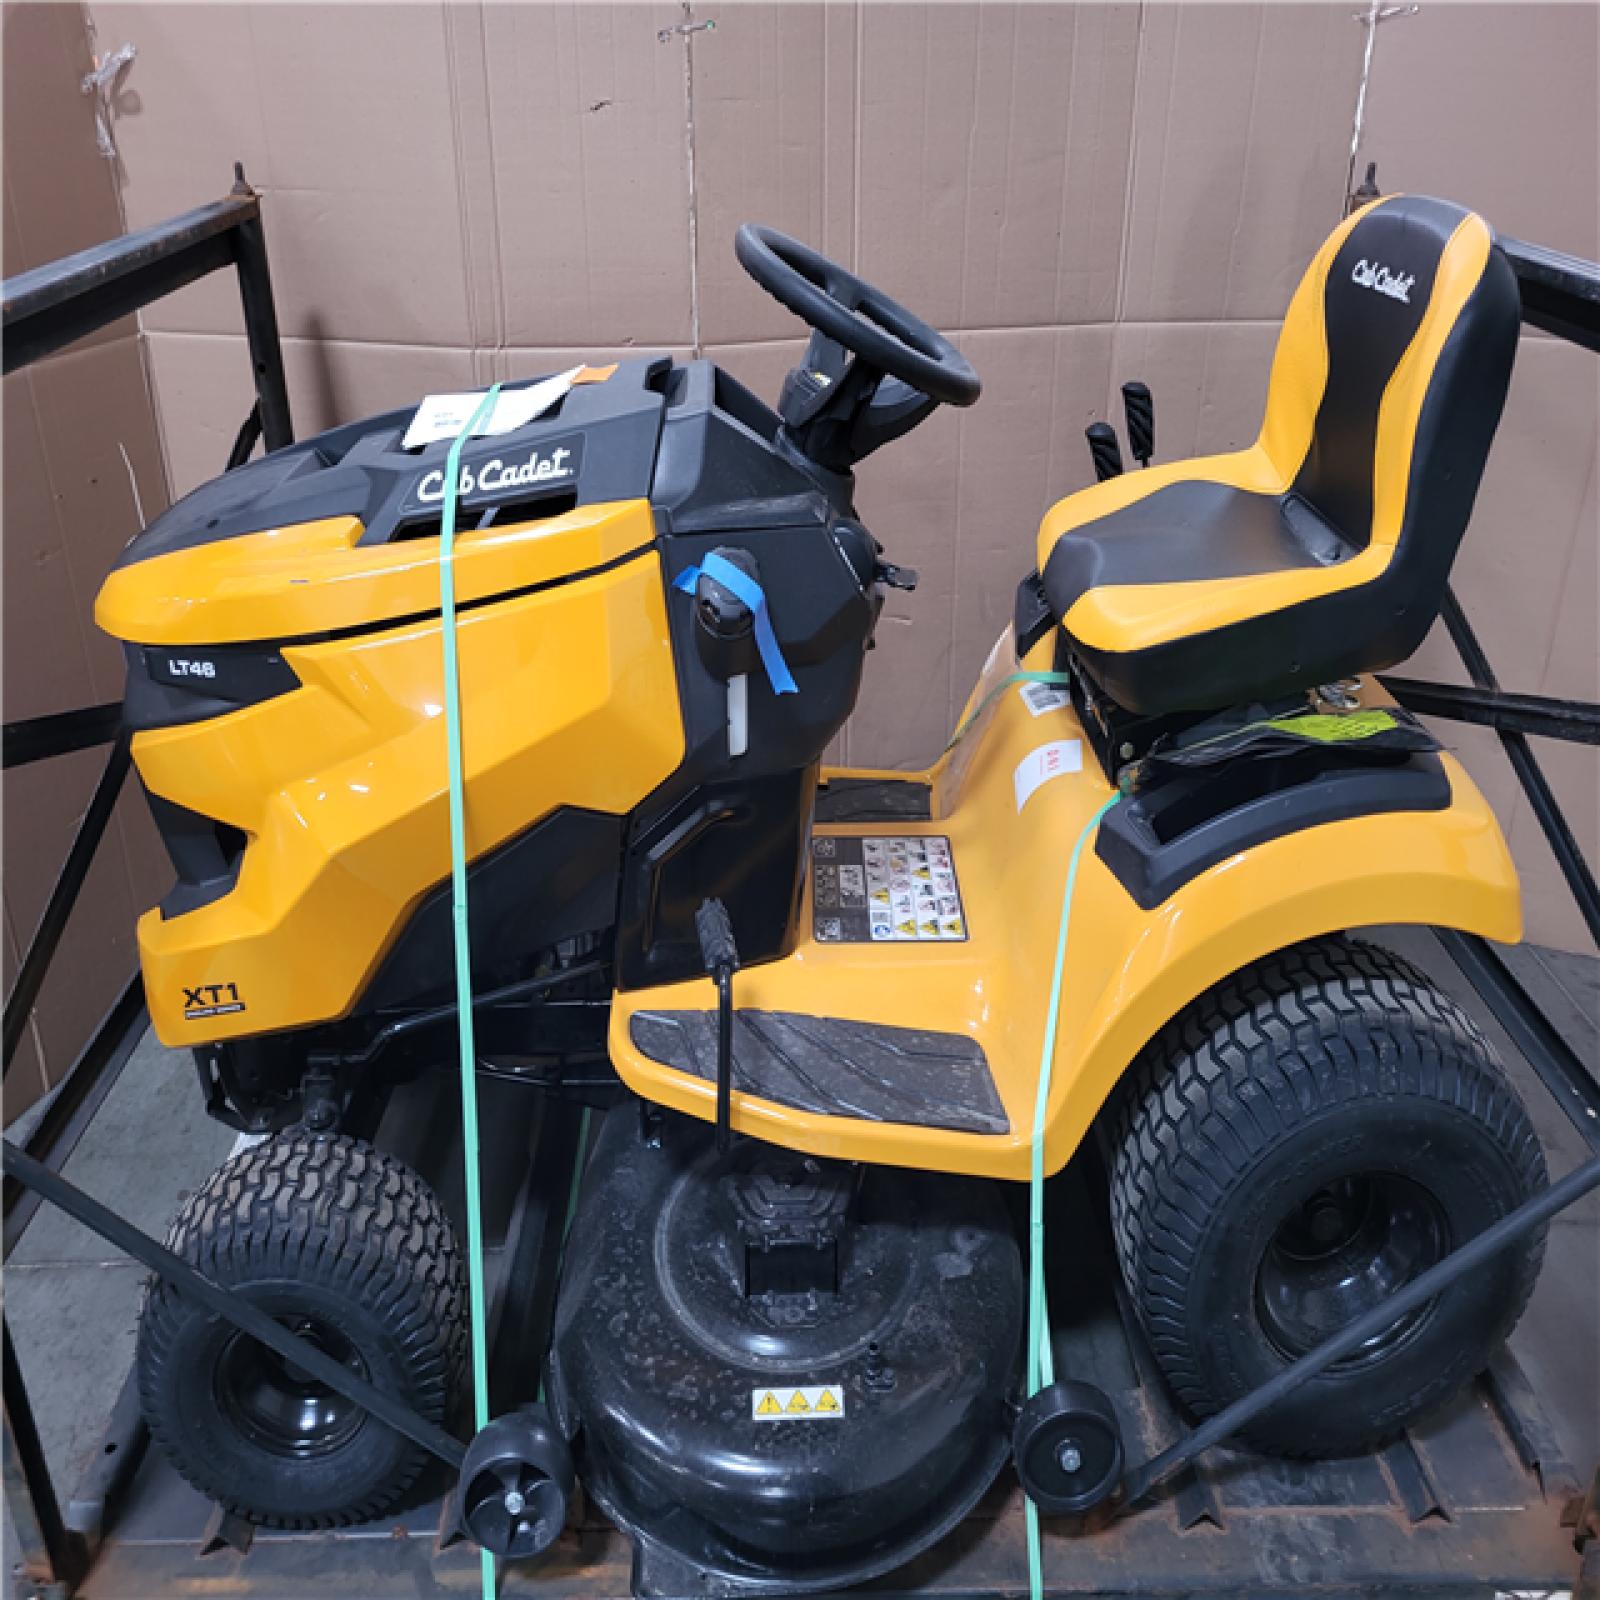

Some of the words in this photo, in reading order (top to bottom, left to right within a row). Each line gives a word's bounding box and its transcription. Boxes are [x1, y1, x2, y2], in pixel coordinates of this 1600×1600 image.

[417, 464, 476, 502] Cb
[478, 447, 571, 491] Cadet
[183, 982, 239, 1008] XT1
